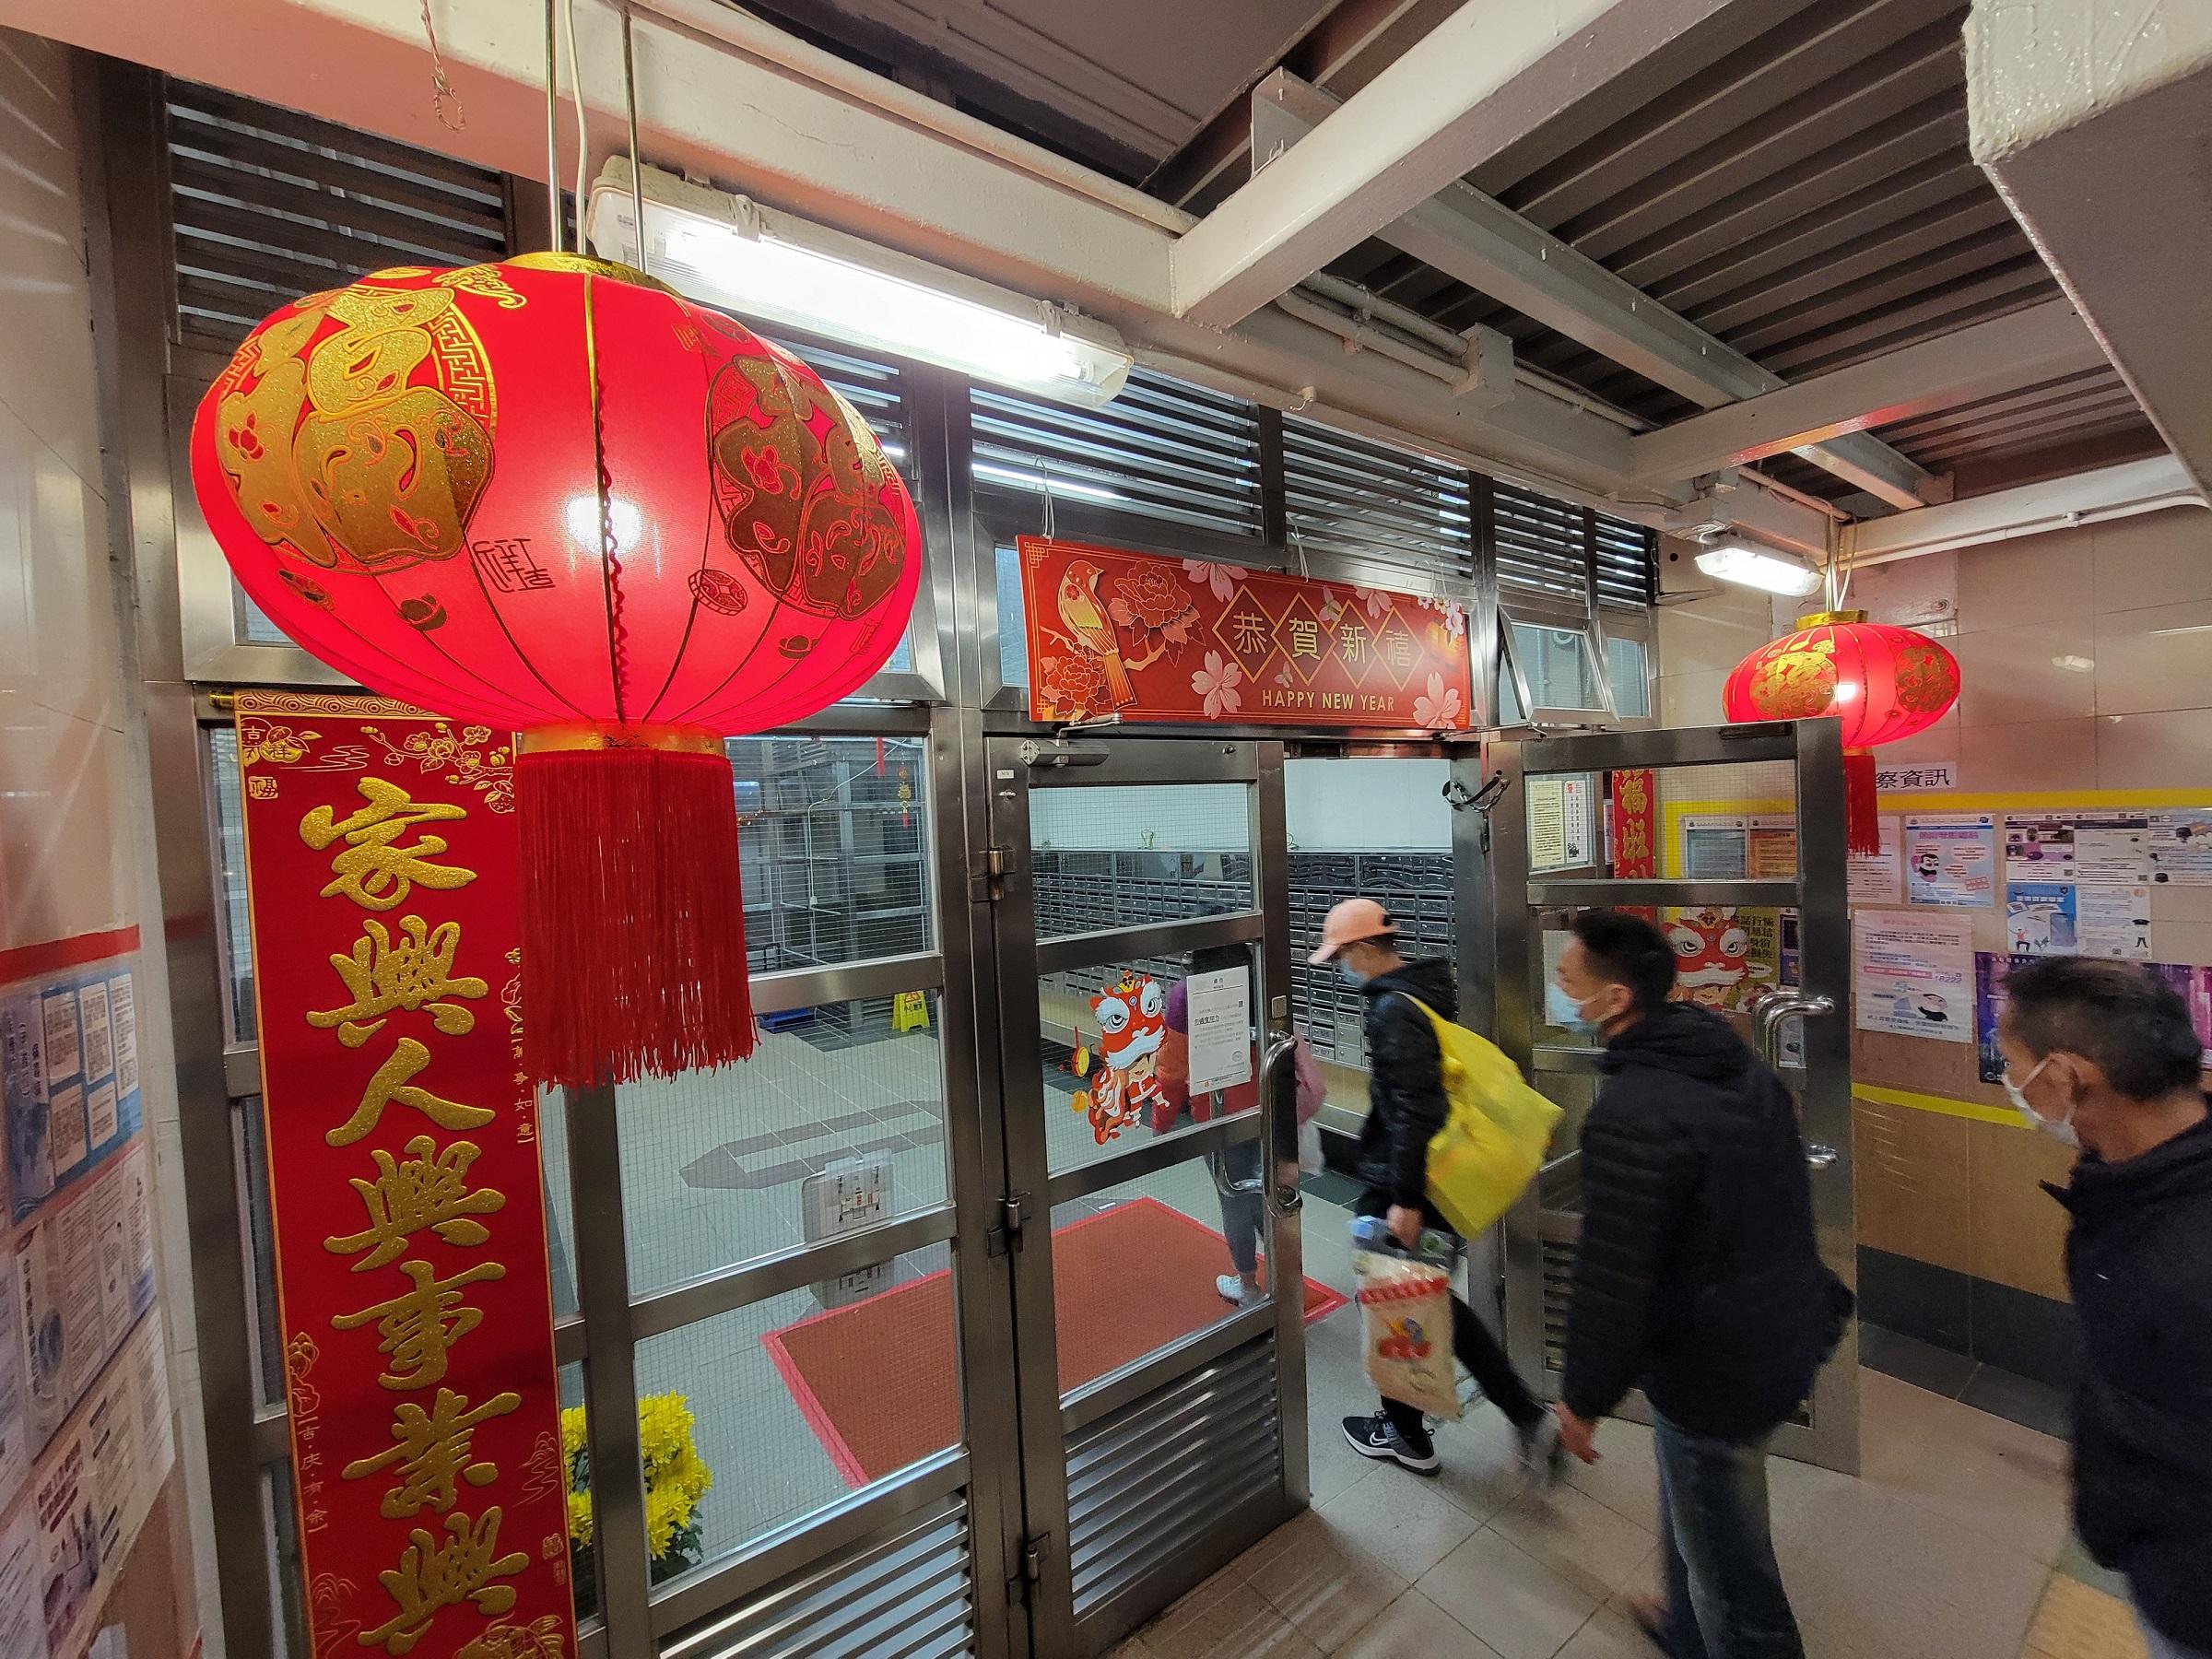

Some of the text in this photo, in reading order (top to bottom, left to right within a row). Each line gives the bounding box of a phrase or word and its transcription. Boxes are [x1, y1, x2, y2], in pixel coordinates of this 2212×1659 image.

[1232, 611, 1411, 667] 恭賀新禧
[1262, 688, 1394, 712] HAPPY NEW YEAR
